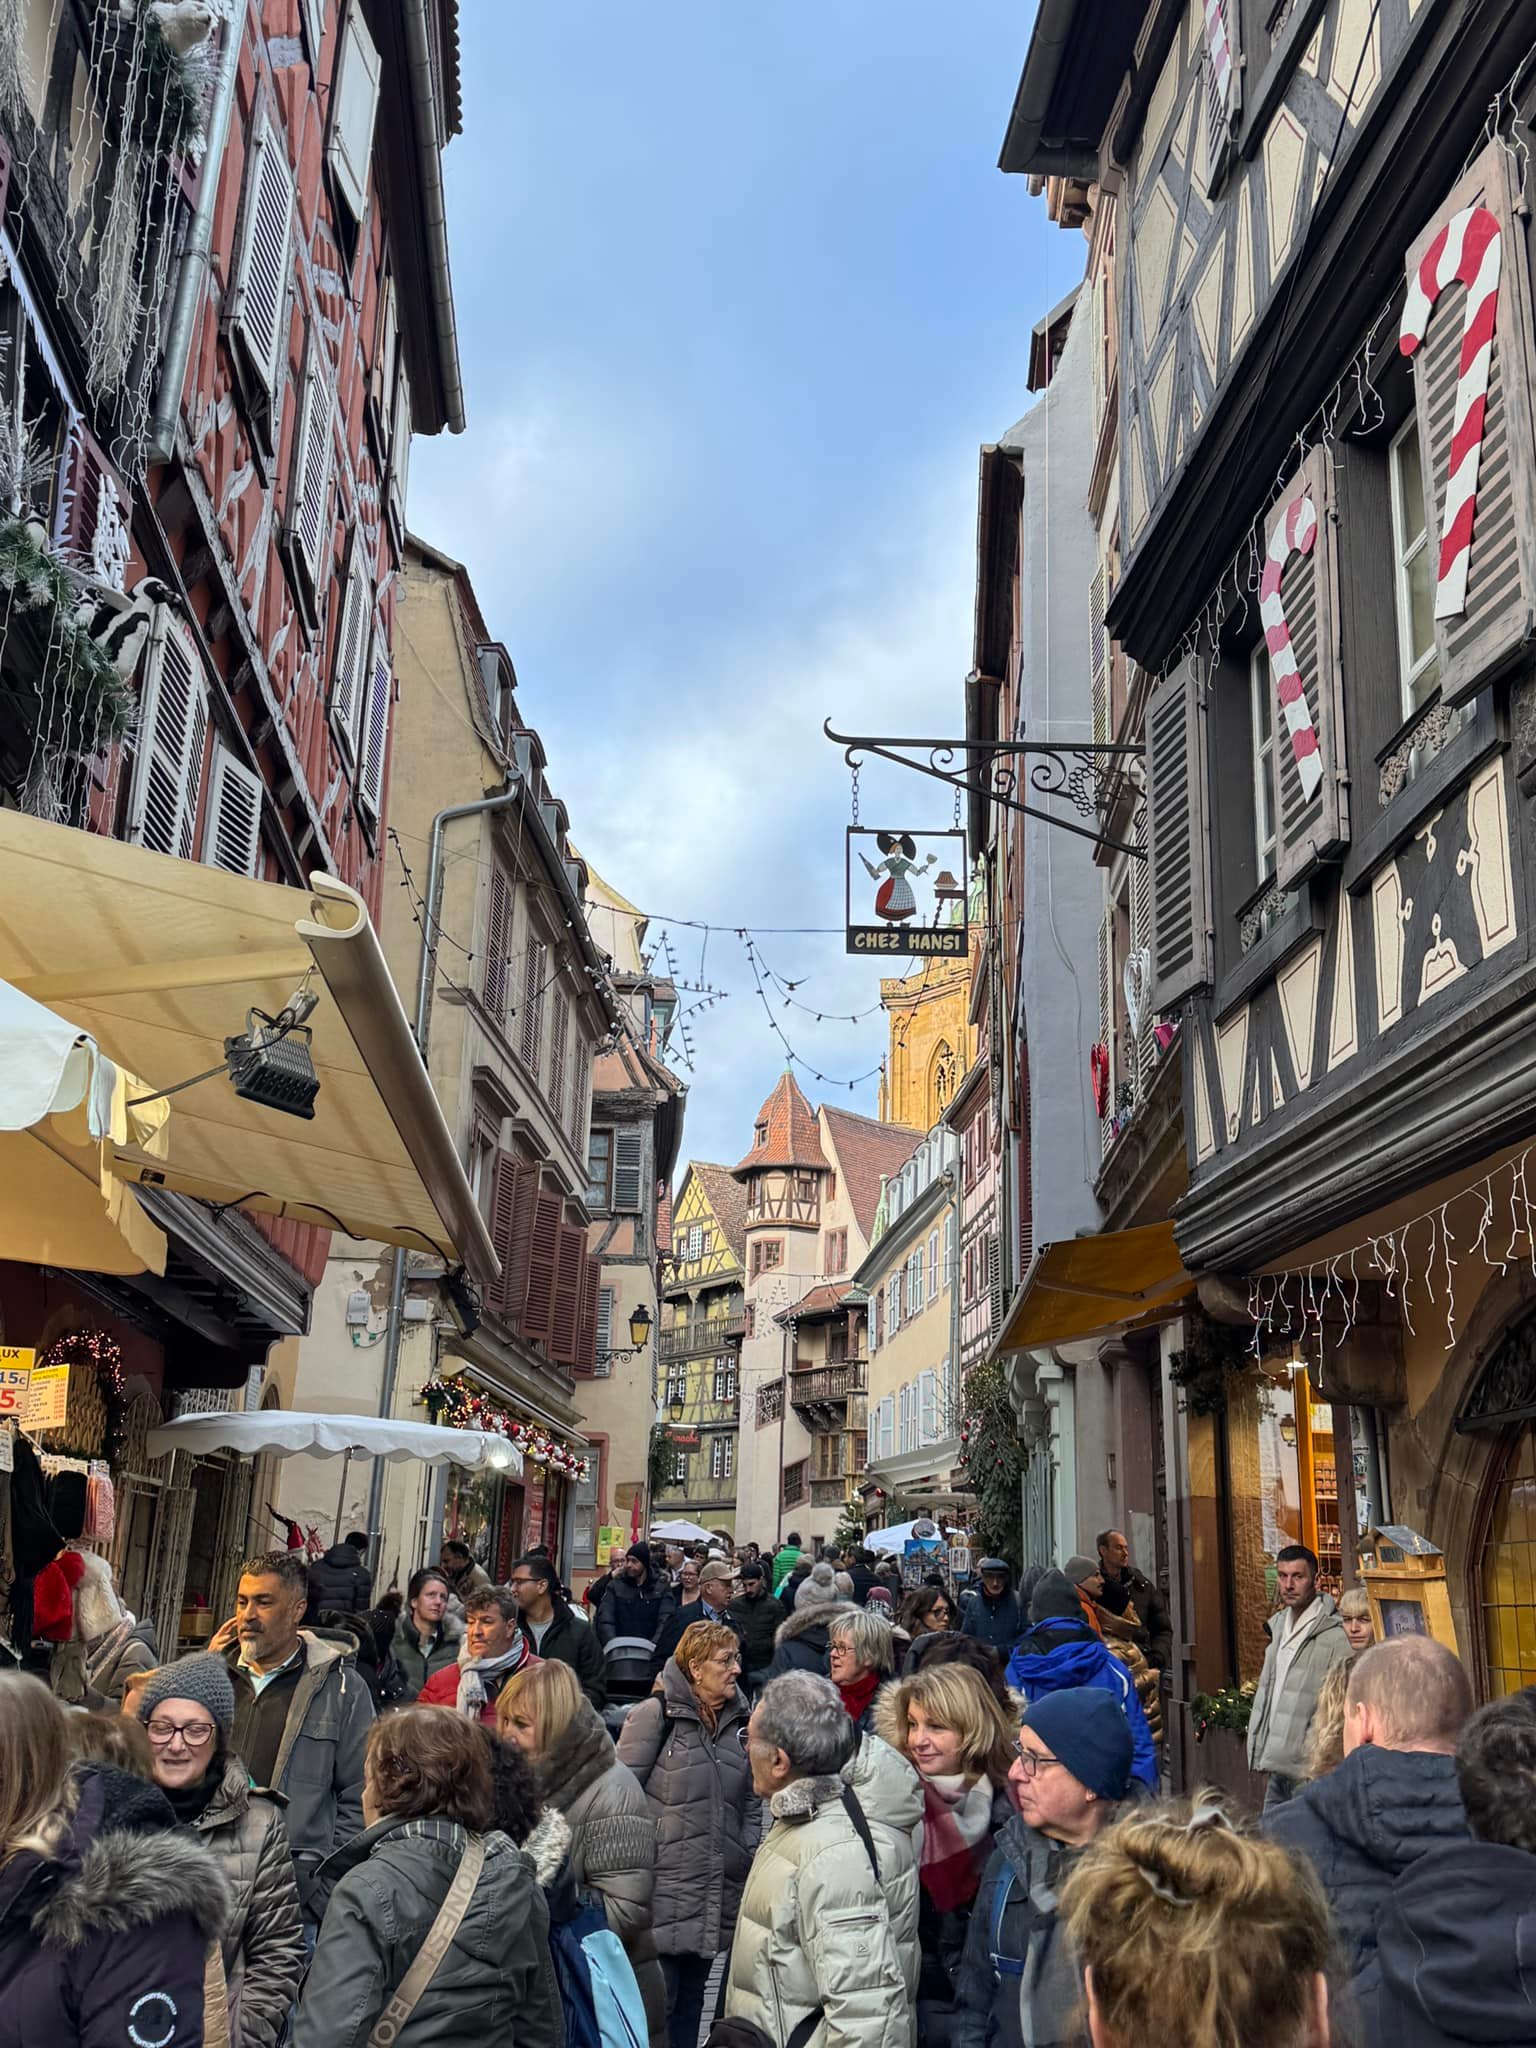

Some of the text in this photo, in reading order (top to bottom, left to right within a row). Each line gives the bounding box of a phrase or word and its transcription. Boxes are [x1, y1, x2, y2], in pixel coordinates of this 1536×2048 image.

[854, 932, 960, 950] CHEZ HANSI
[0, 1348, 20, 1359] UX
[368, 1994, 413, 2048] BO
